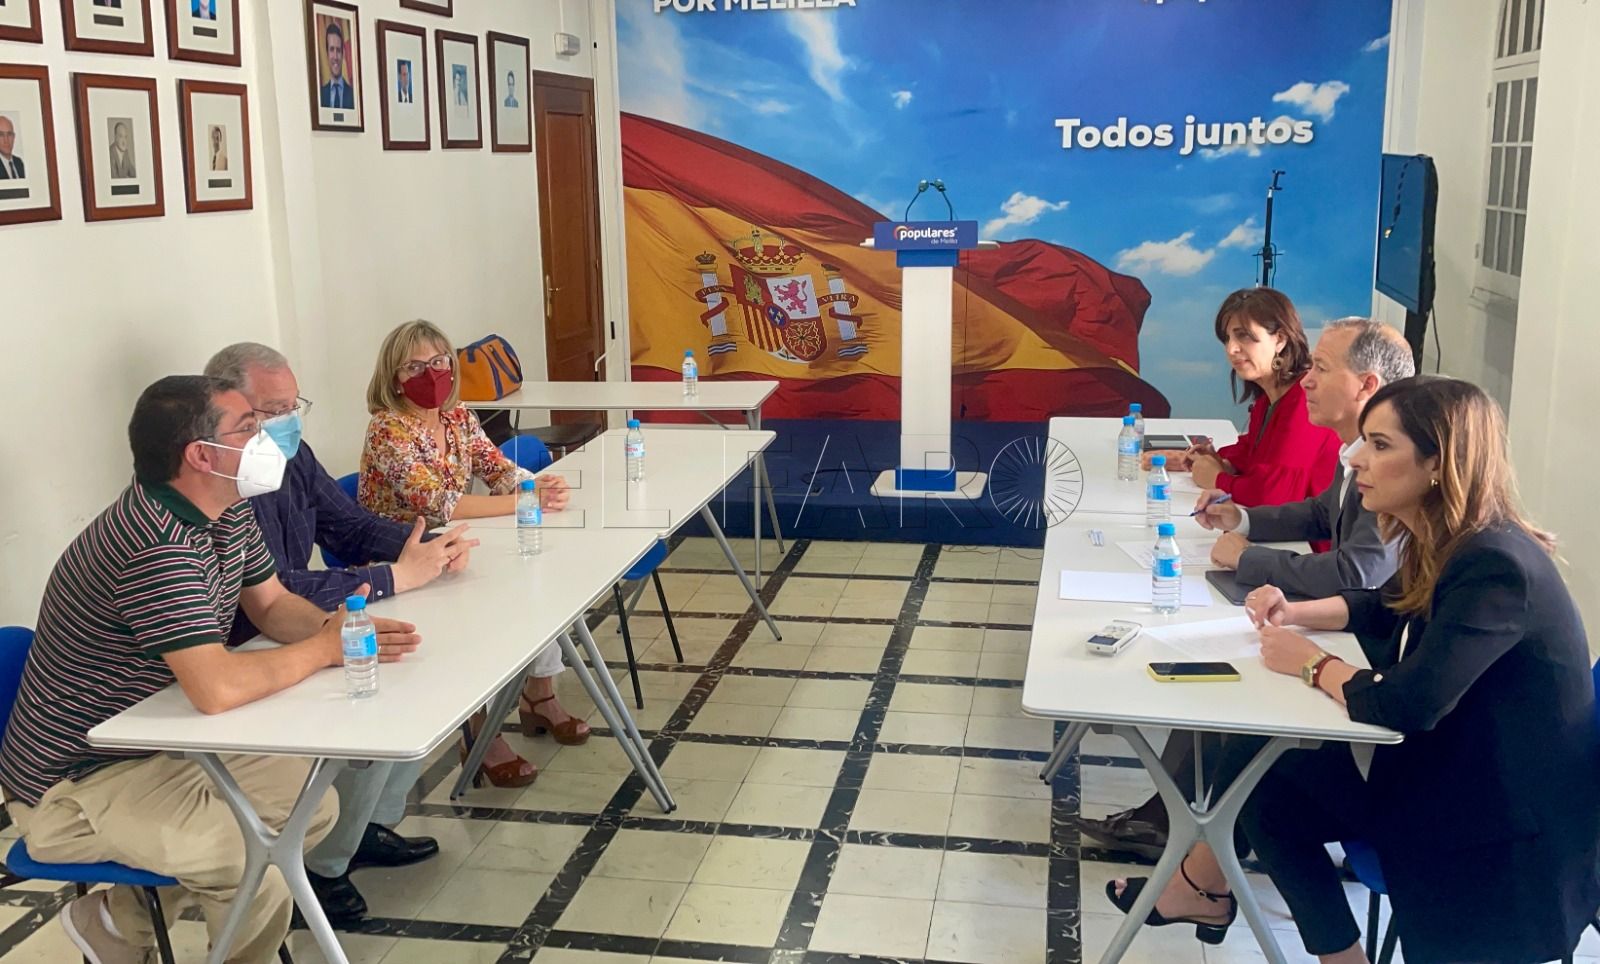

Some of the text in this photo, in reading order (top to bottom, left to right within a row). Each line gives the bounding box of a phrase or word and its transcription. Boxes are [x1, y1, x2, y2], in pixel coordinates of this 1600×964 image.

[1055, 115, 1313, 155] Todos juntos
[900, 227, 956, 240] populares
